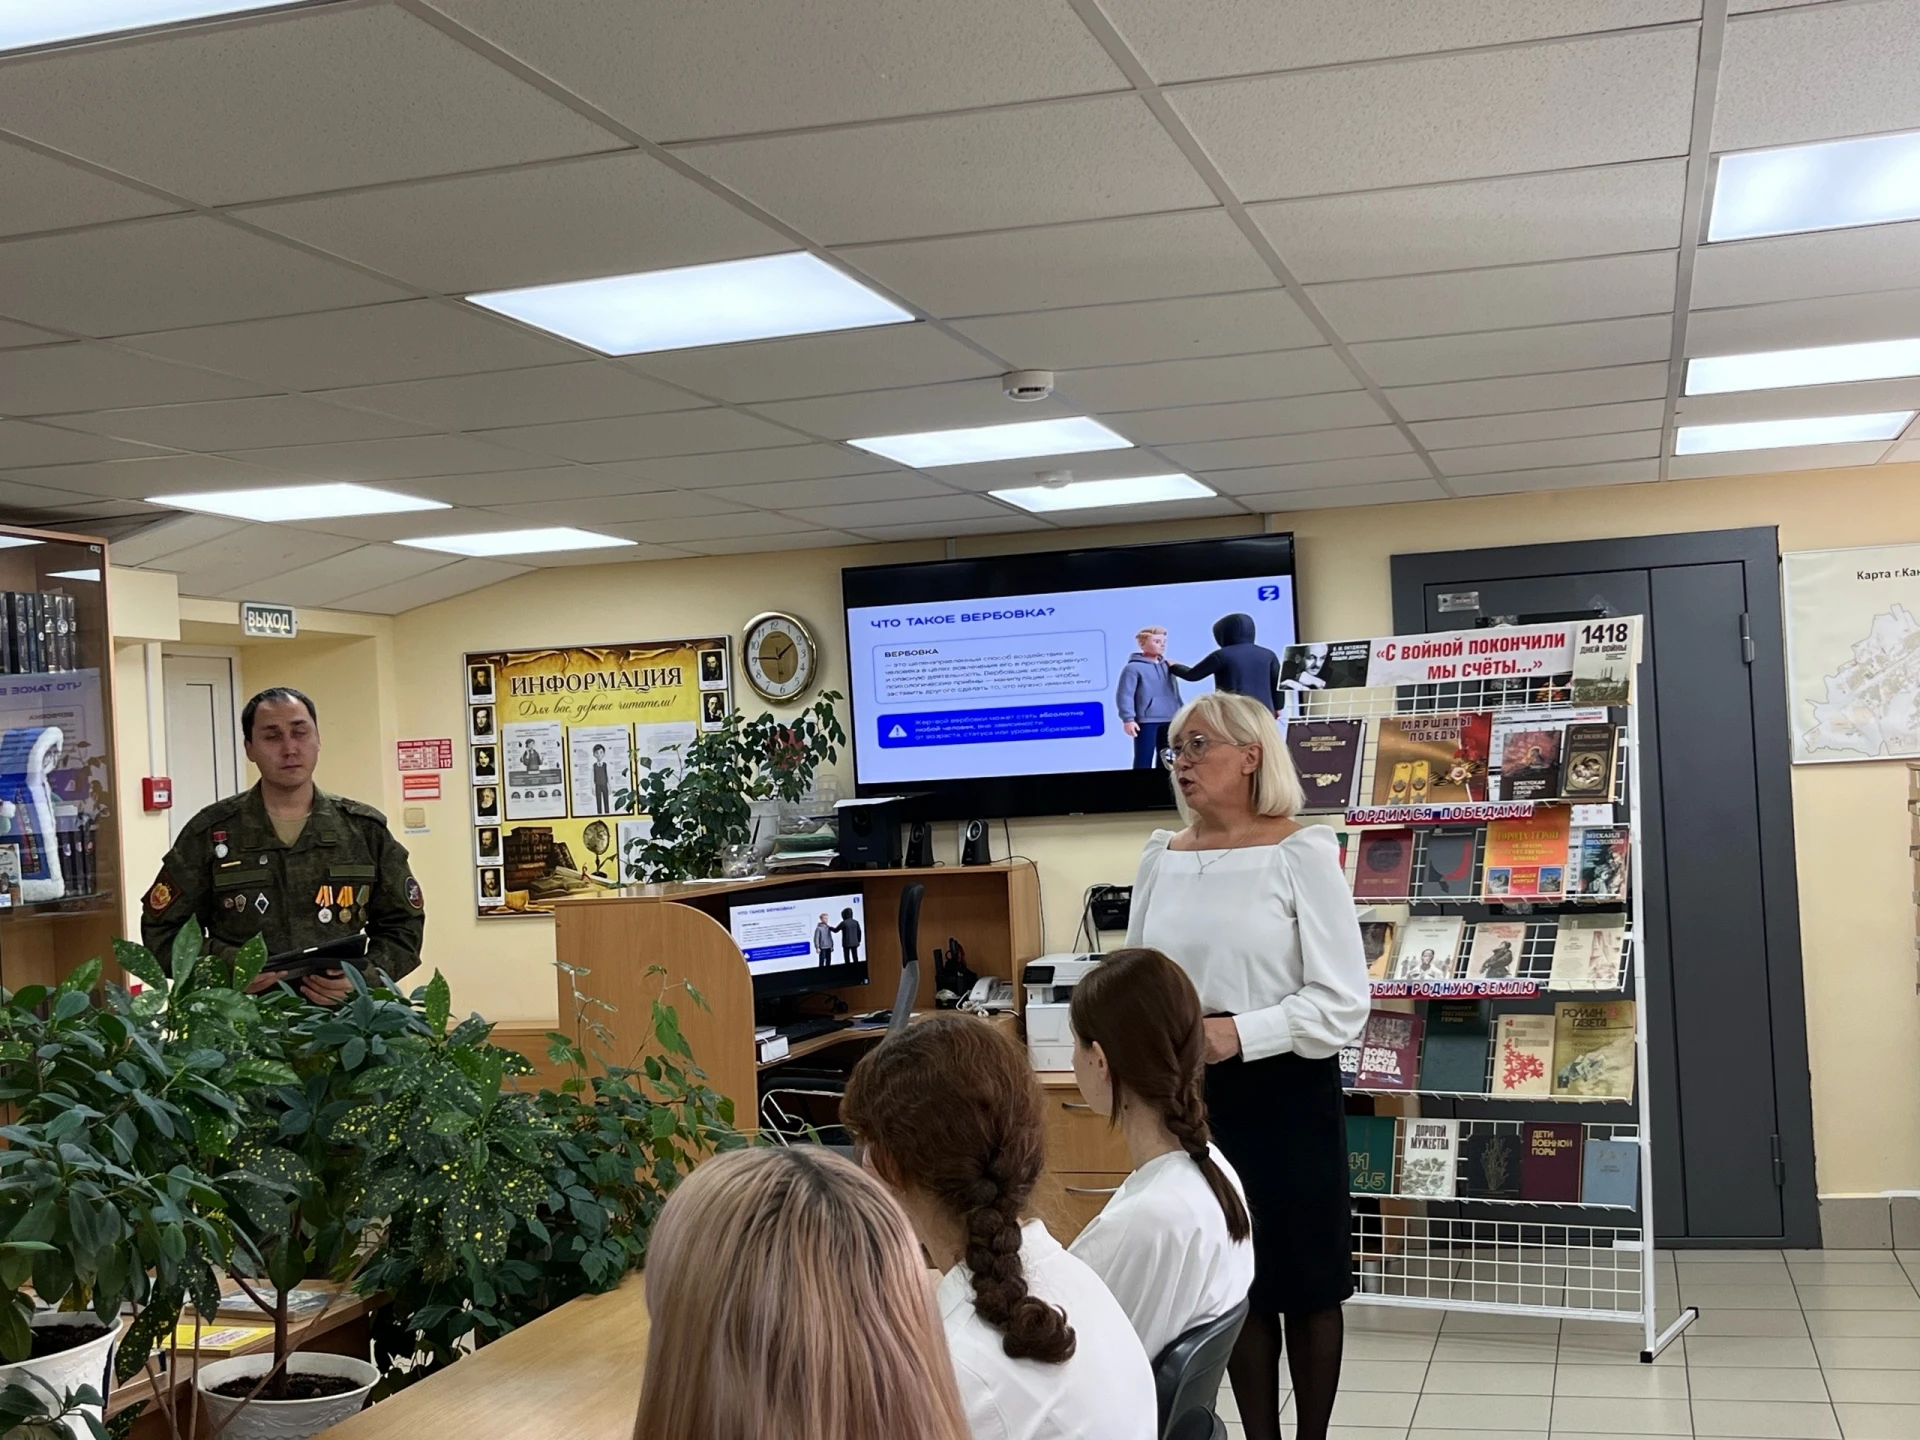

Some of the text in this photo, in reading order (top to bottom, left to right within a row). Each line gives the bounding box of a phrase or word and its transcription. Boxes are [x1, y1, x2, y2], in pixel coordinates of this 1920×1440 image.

[1857, 570, 1891, 582] Карта
[248, 610, 290, 630] ВЫХОД
[870, 607, 1056, 629] ЧТО ТАКОЕ ВЕРБОВКА?
[769, 621, 779, 630] 12
[787, 625, 790, 634] 1
[758, 628, 765, 638] 11
[1581, 623, 1628, 644] 1418
[751, 641, 759, 650] 10
[796, 636, 802, 646] 2
[801, 649, 806, 658] 3
[884, 648, 939, 658] ВЕРБОВКА
[752, 656, 757, 666] 9
[800, 663, 806, 672] 4
[756, 670, 762, 679] 8
[510, 667, 683, 694] ИНФОРМАЦИЯ
[765, 681, 771, 691] 7
[780, 685, 786, 694] 6
[519, 700, 549, 716] Для
[568, 694, 612, 723] дорогие
[618, 694, 677, 708] читатели!
[1401, 716, 1472, 730] МАРШАЛЫ
[1410, 730, 1460, 742] ПОБЕДЫ
[440, 758, 452, 768] 112
[1346, 804, 1534, 824] ГОРДИМСЯ ПОБЕДАМИ
[1369, 981, 1536, 996] БИМ РОДНУЮ ЗЕМЛЮ
[1572, 1018, 1607, 1028] ГАЗЕТА
[1364, 1047, 1398, 1060] ВОЙНА
[1363, 1054, 1397, 1066] НАРОД
[1362, 1062, 1401, 1075] ПОБЕДА
[1416, 1124, 1447, 1138] ДОРОГОЙ
[1532, 1130, 1554, 1139] ДЕТИ
[1410, 1138, 1449, 1150] МУЖЕСТВА
[1532, 1138, 1573, 1148] ВОЕННОЙ
[1532, 1148, 1556, 1156] ПОРЫ
[1348, 1152, 1370, 1170] 41
[1354, 1172, 1386, 1190] 45
